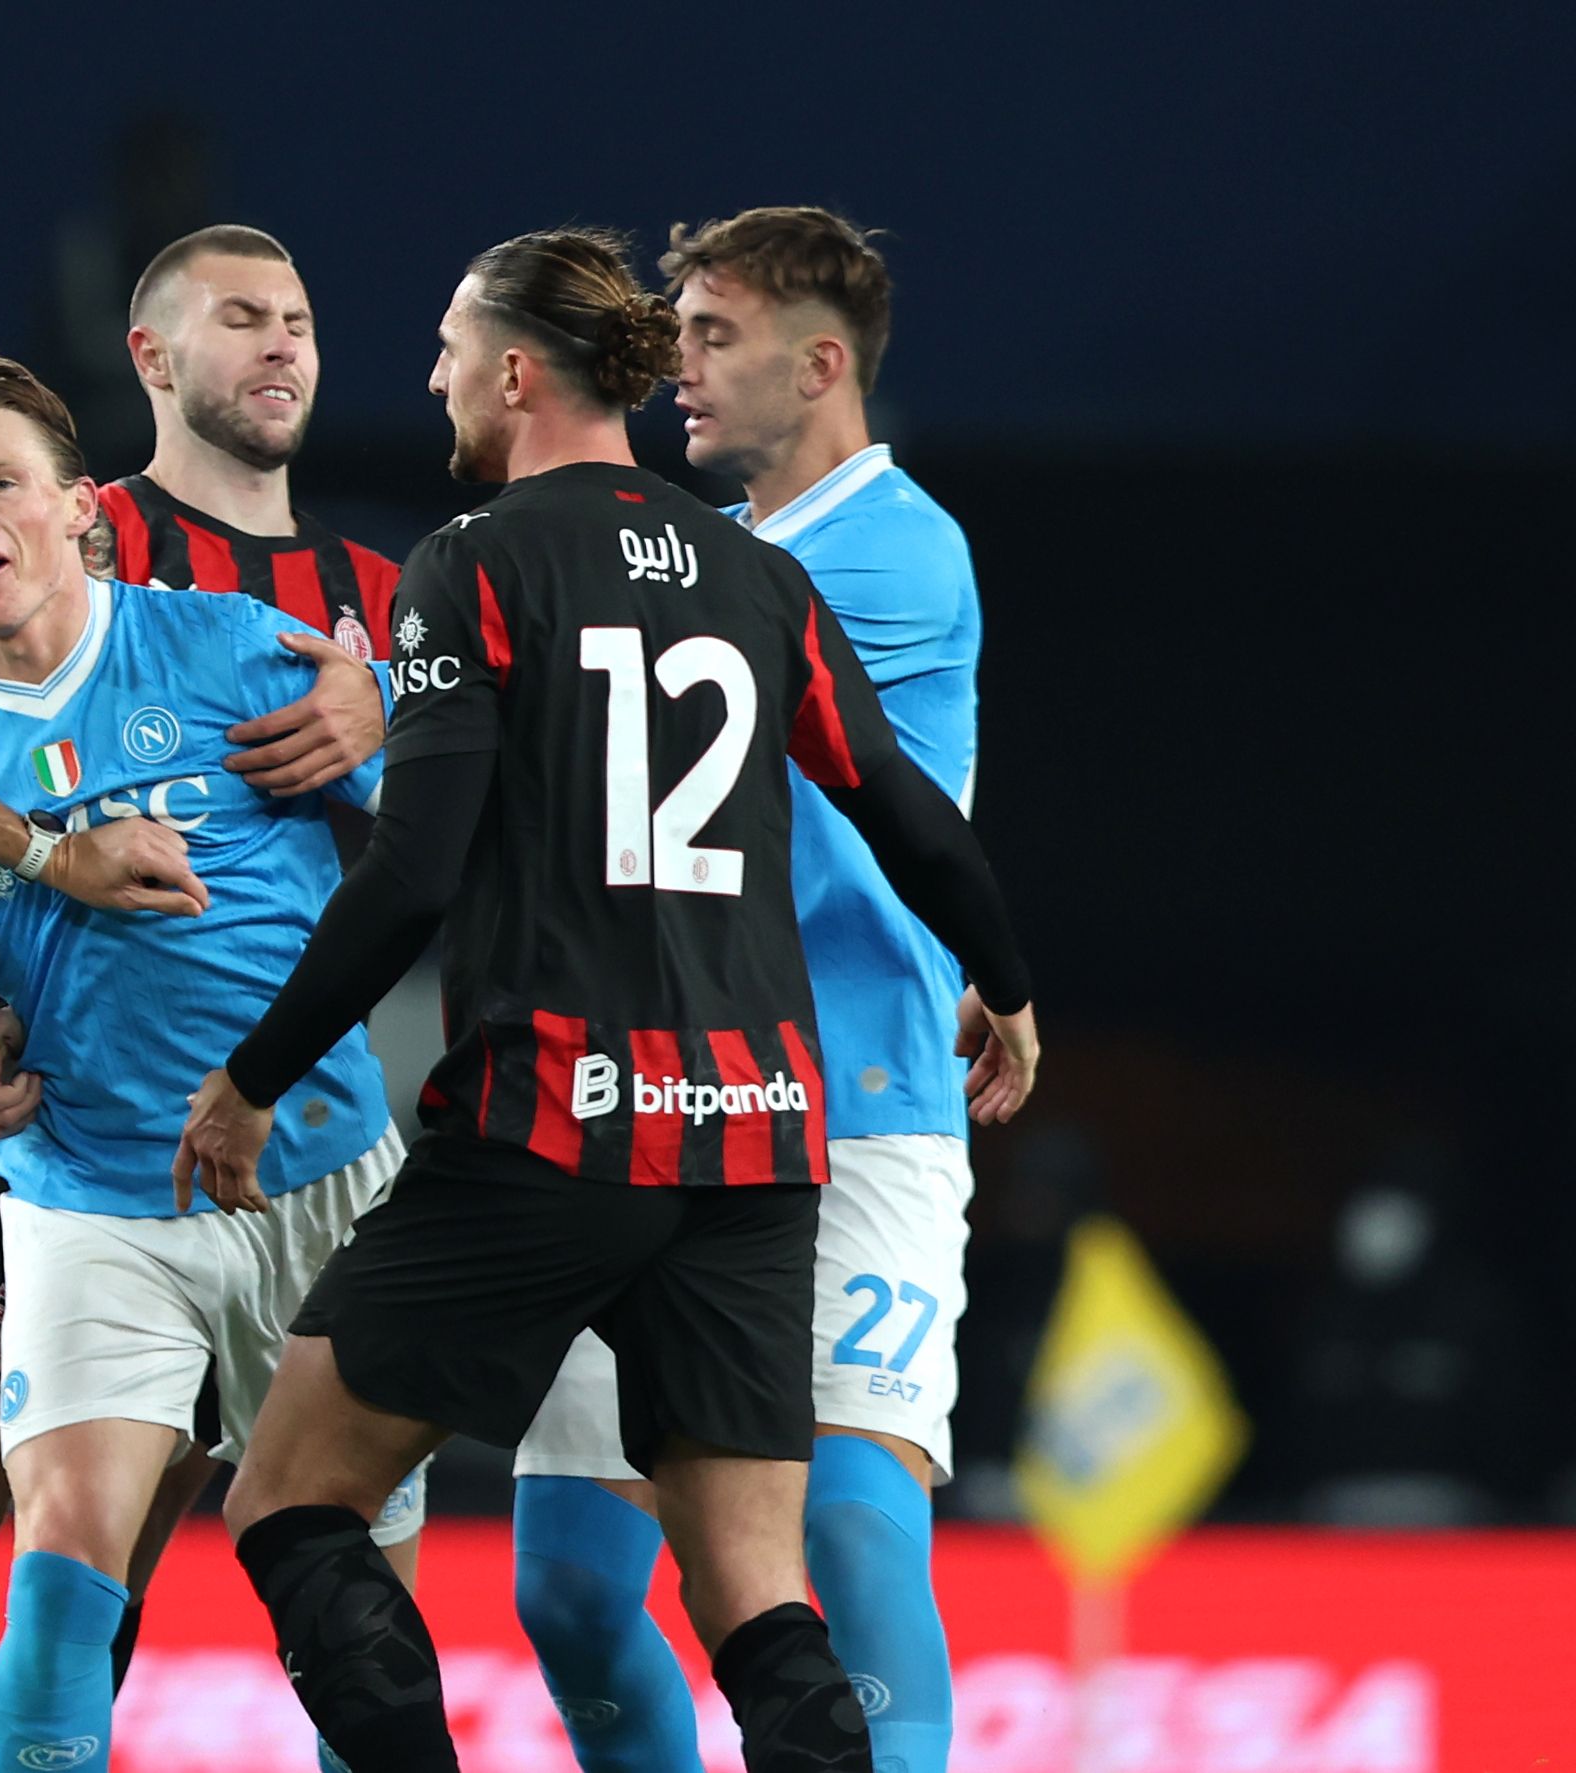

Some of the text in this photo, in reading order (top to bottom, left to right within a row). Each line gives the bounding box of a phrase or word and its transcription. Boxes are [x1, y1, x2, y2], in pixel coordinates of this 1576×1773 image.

[619, 523, 698, 588] رابيو
[580, 627, 758, 896] 12
[633, 1070, 810, 1126] bitpanda
[831, 1273, 938, 1373] 27
[868, 1373, 922, 1403] EA7
